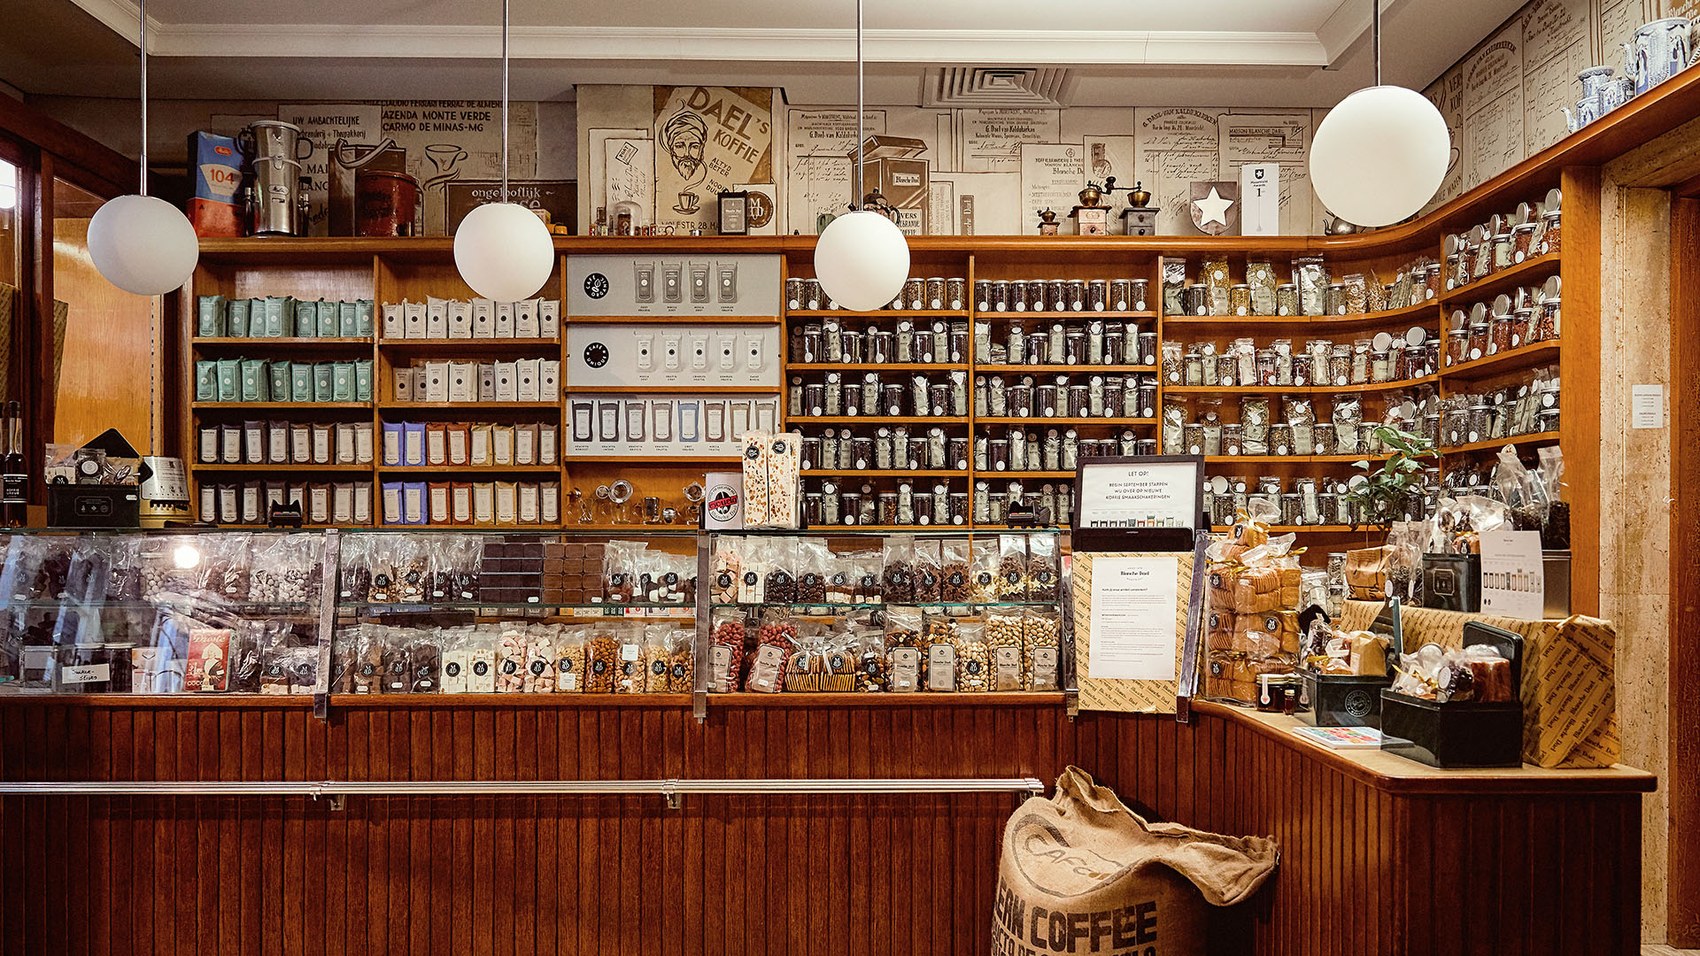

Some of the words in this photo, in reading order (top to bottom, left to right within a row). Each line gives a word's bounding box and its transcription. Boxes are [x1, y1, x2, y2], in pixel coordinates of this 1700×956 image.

[422, 111, 456, 120] MONTE
[460, 112, 490, 120] VERDE
[382, 122, 416, 132] CARMO
[420, 122, 430, 131] DE
[433, 123, 484, 132] MINAS-MG
[712, 129, 760, 164] KOFFIE
[210, 168, 234, 184] 104
[708, 163, 730, 177] BETER
[1030, 901, 1158, 952] COFFEE
